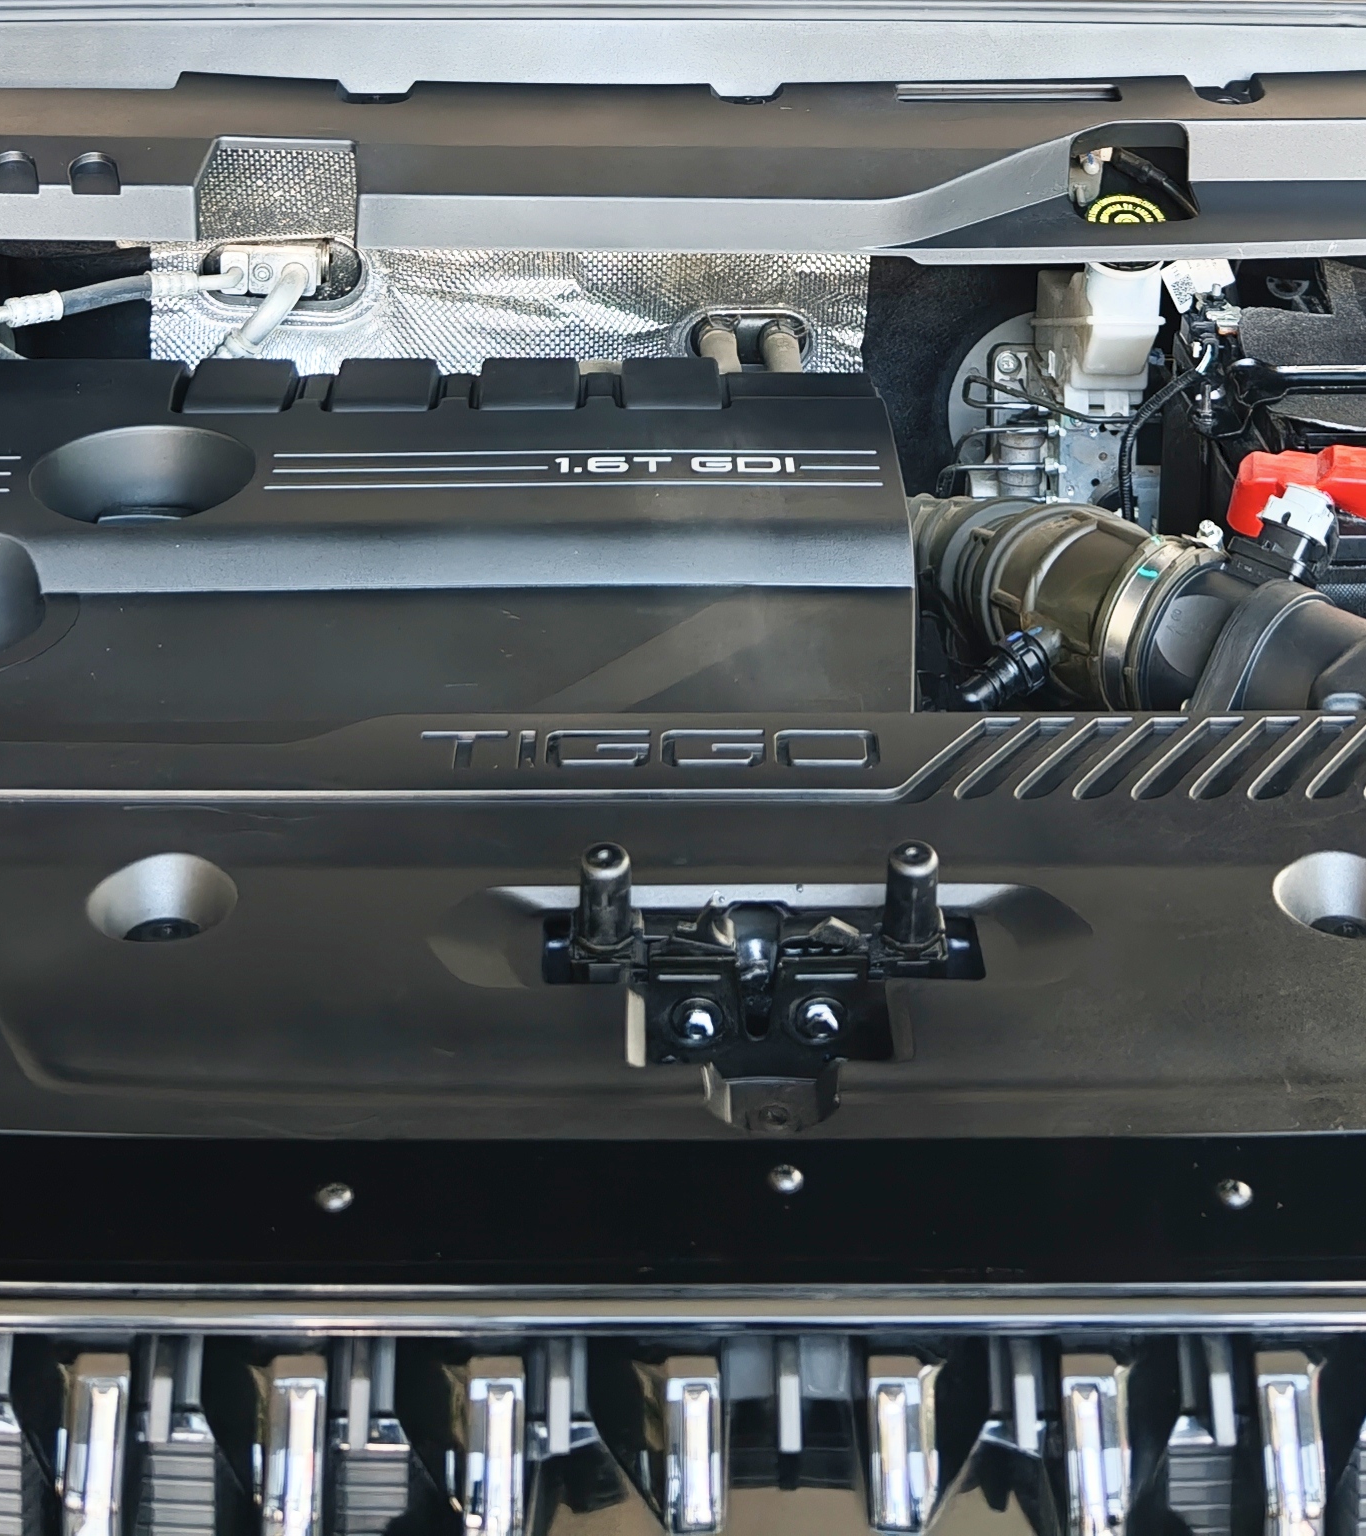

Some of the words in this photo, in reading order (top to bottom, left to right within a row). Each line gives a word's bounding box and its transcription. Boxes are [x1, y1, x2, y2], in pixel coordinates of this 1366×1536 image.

[553, 455, 673, 475] 1.6T
[690, 455, 796, 475] GDI
[421, 727, 881, 770] TIGGO
